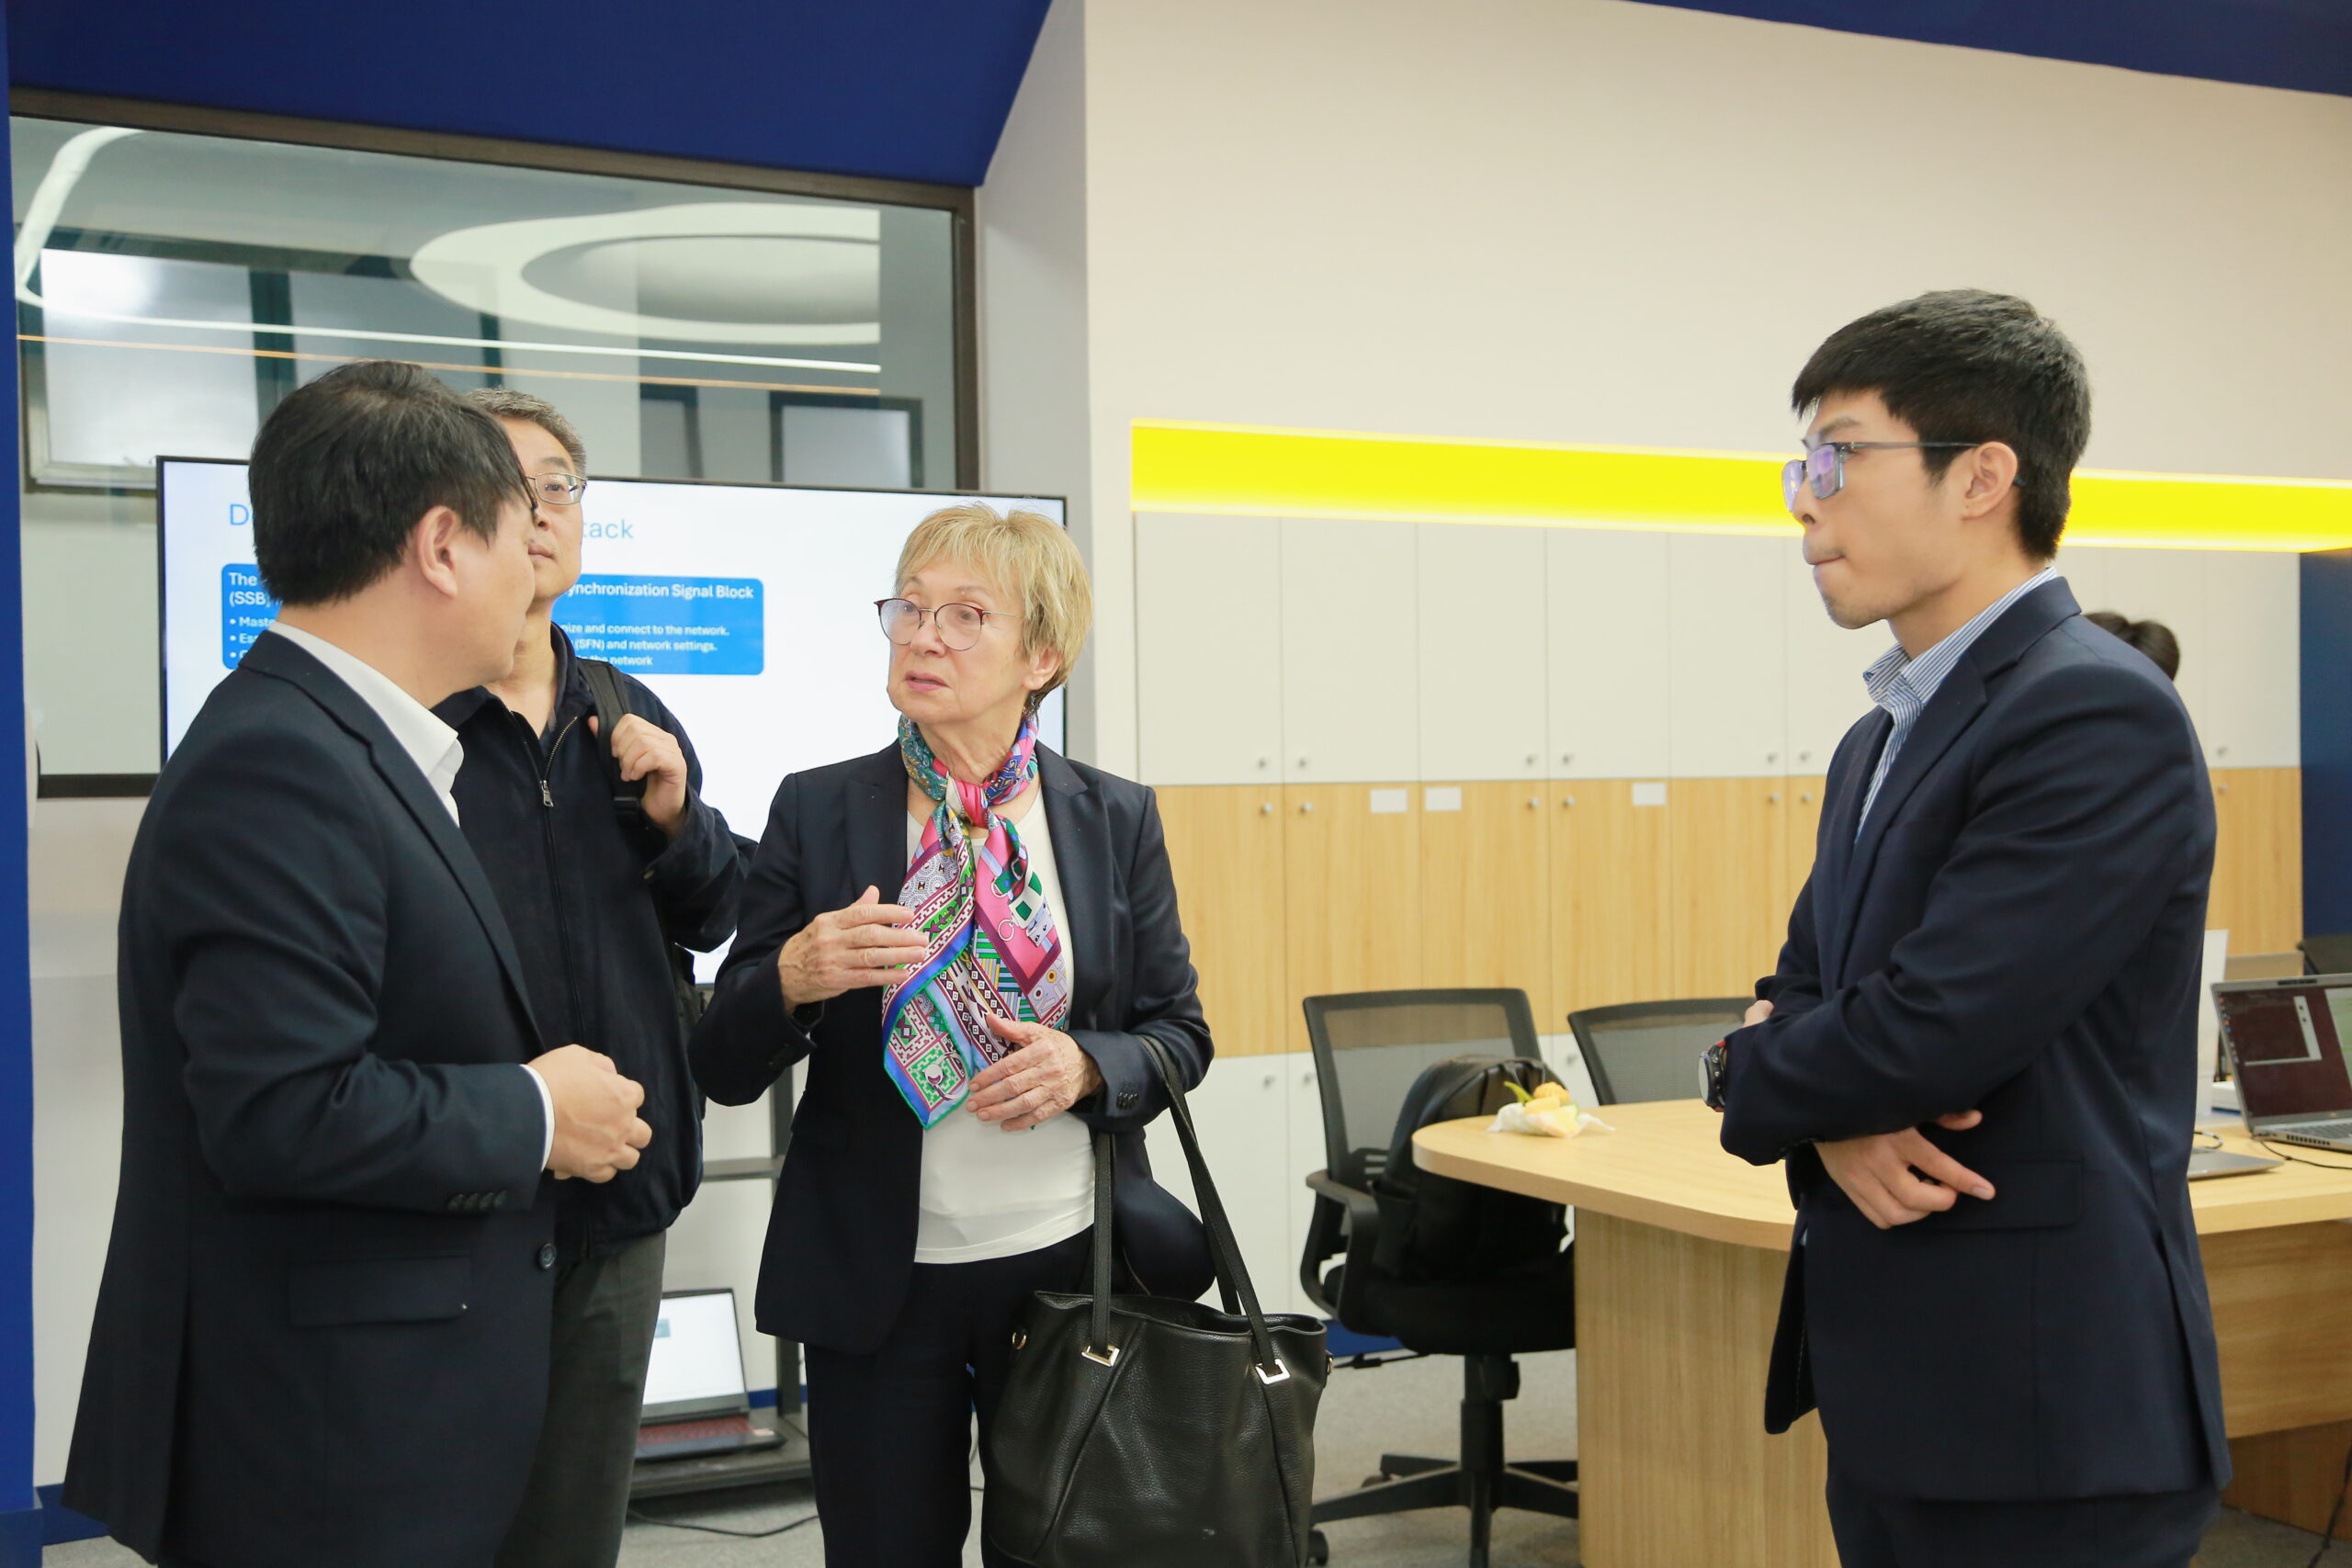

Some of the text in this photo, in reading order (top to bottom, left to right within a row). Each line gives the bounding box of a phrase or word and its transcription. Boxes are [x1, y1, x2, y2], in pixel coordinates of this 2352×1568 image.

[582, 519, 634, 539] ack
[228, 572, 753, 600] The ynchronization Signal Block
[585, 624, 606, 634] and
[607, 625, 650, 635] connect
[652, 626, 663, 635] to
[665, 626, 683, 636] the
[684, 626, 729, 637] network.
[575, 638, 605, 651] (SFN)
[606, 640, 628, 650] and
[629, 641, 672, 651] network
[673, 641, 718, 653] settings.
[609, 655, 653, 666] network
